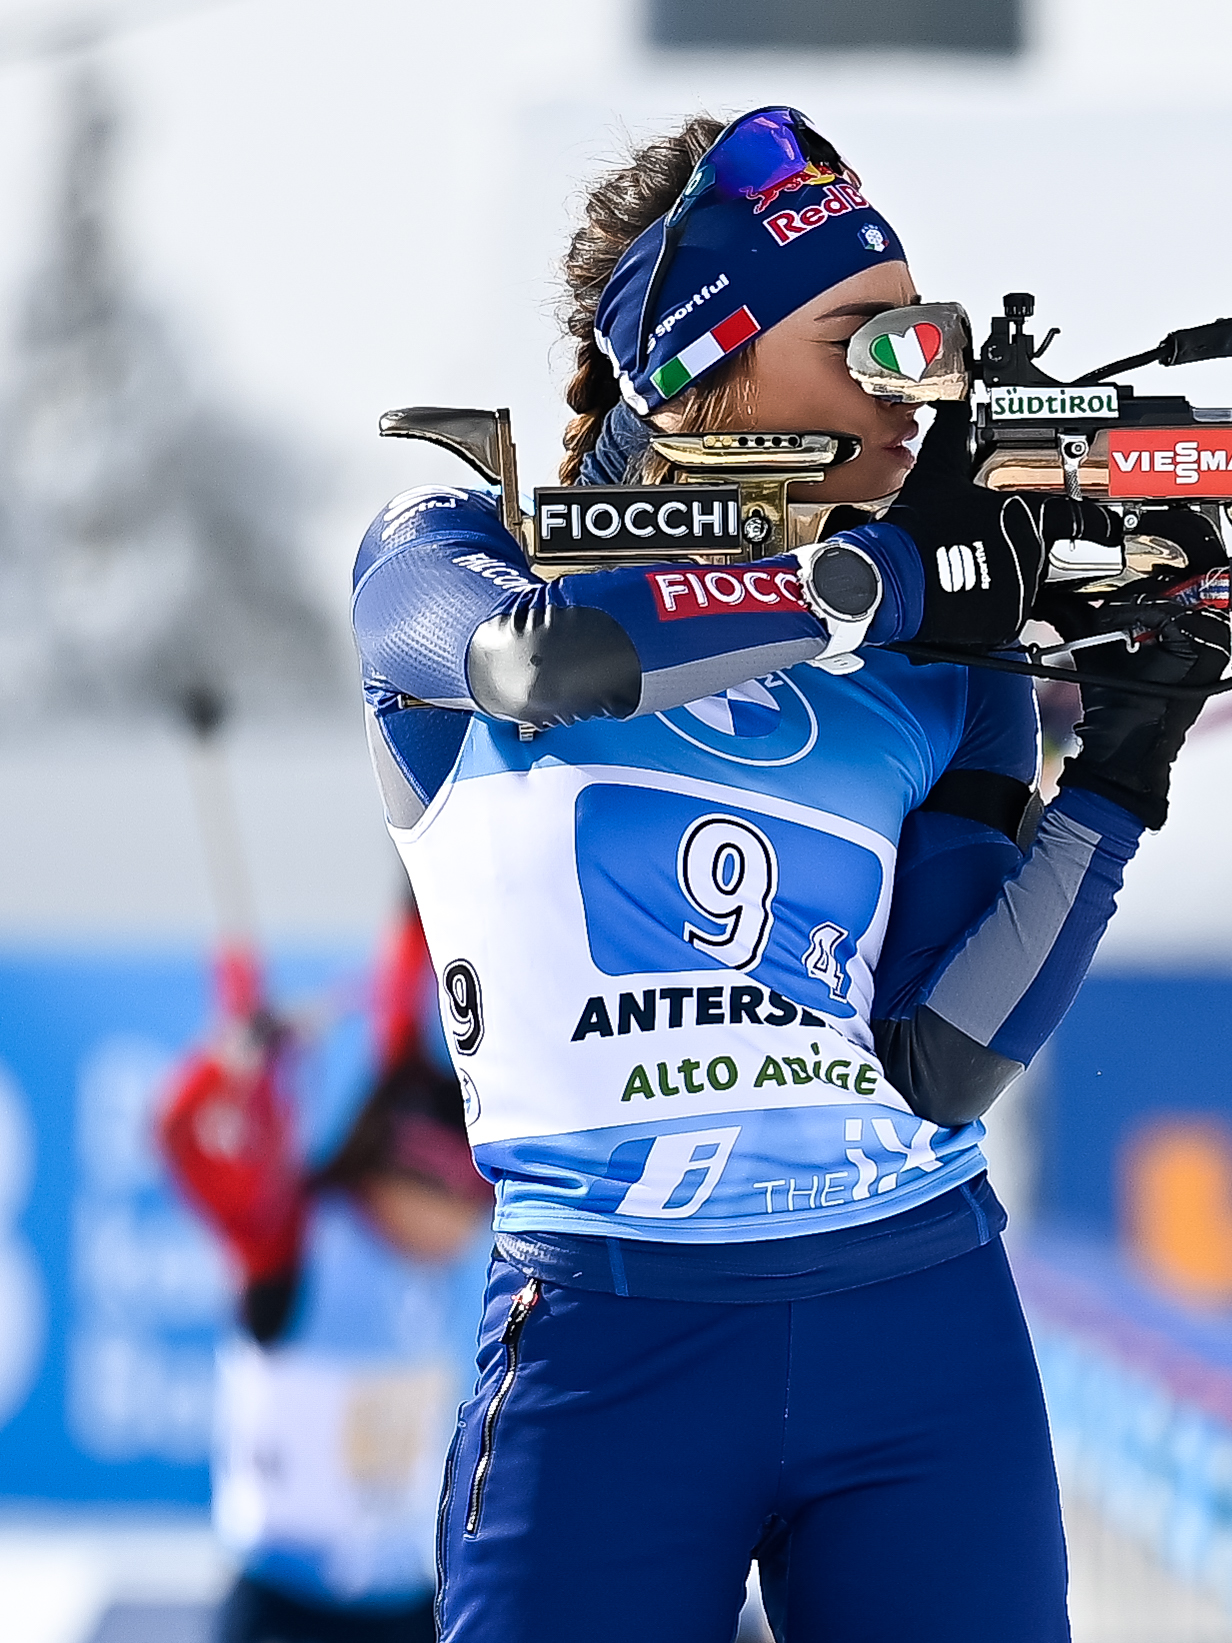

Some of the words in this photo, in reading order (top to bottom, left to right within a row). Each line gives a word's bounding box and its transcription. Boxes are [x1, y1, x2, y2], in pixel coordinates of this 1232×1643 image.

[654, 273, 730, 340] sportful
[540, 501, 738, 540] FIOCCHI
[655, 571, 808, 611] FIOCC
[678, 813, 778, 972] 9
[801, 921, 855, 1003] 4
[442, 957, 486, 1057] 9
[570, 985, 830, 1042] ANTERS
[753, 1171, 848, 1214] THE
